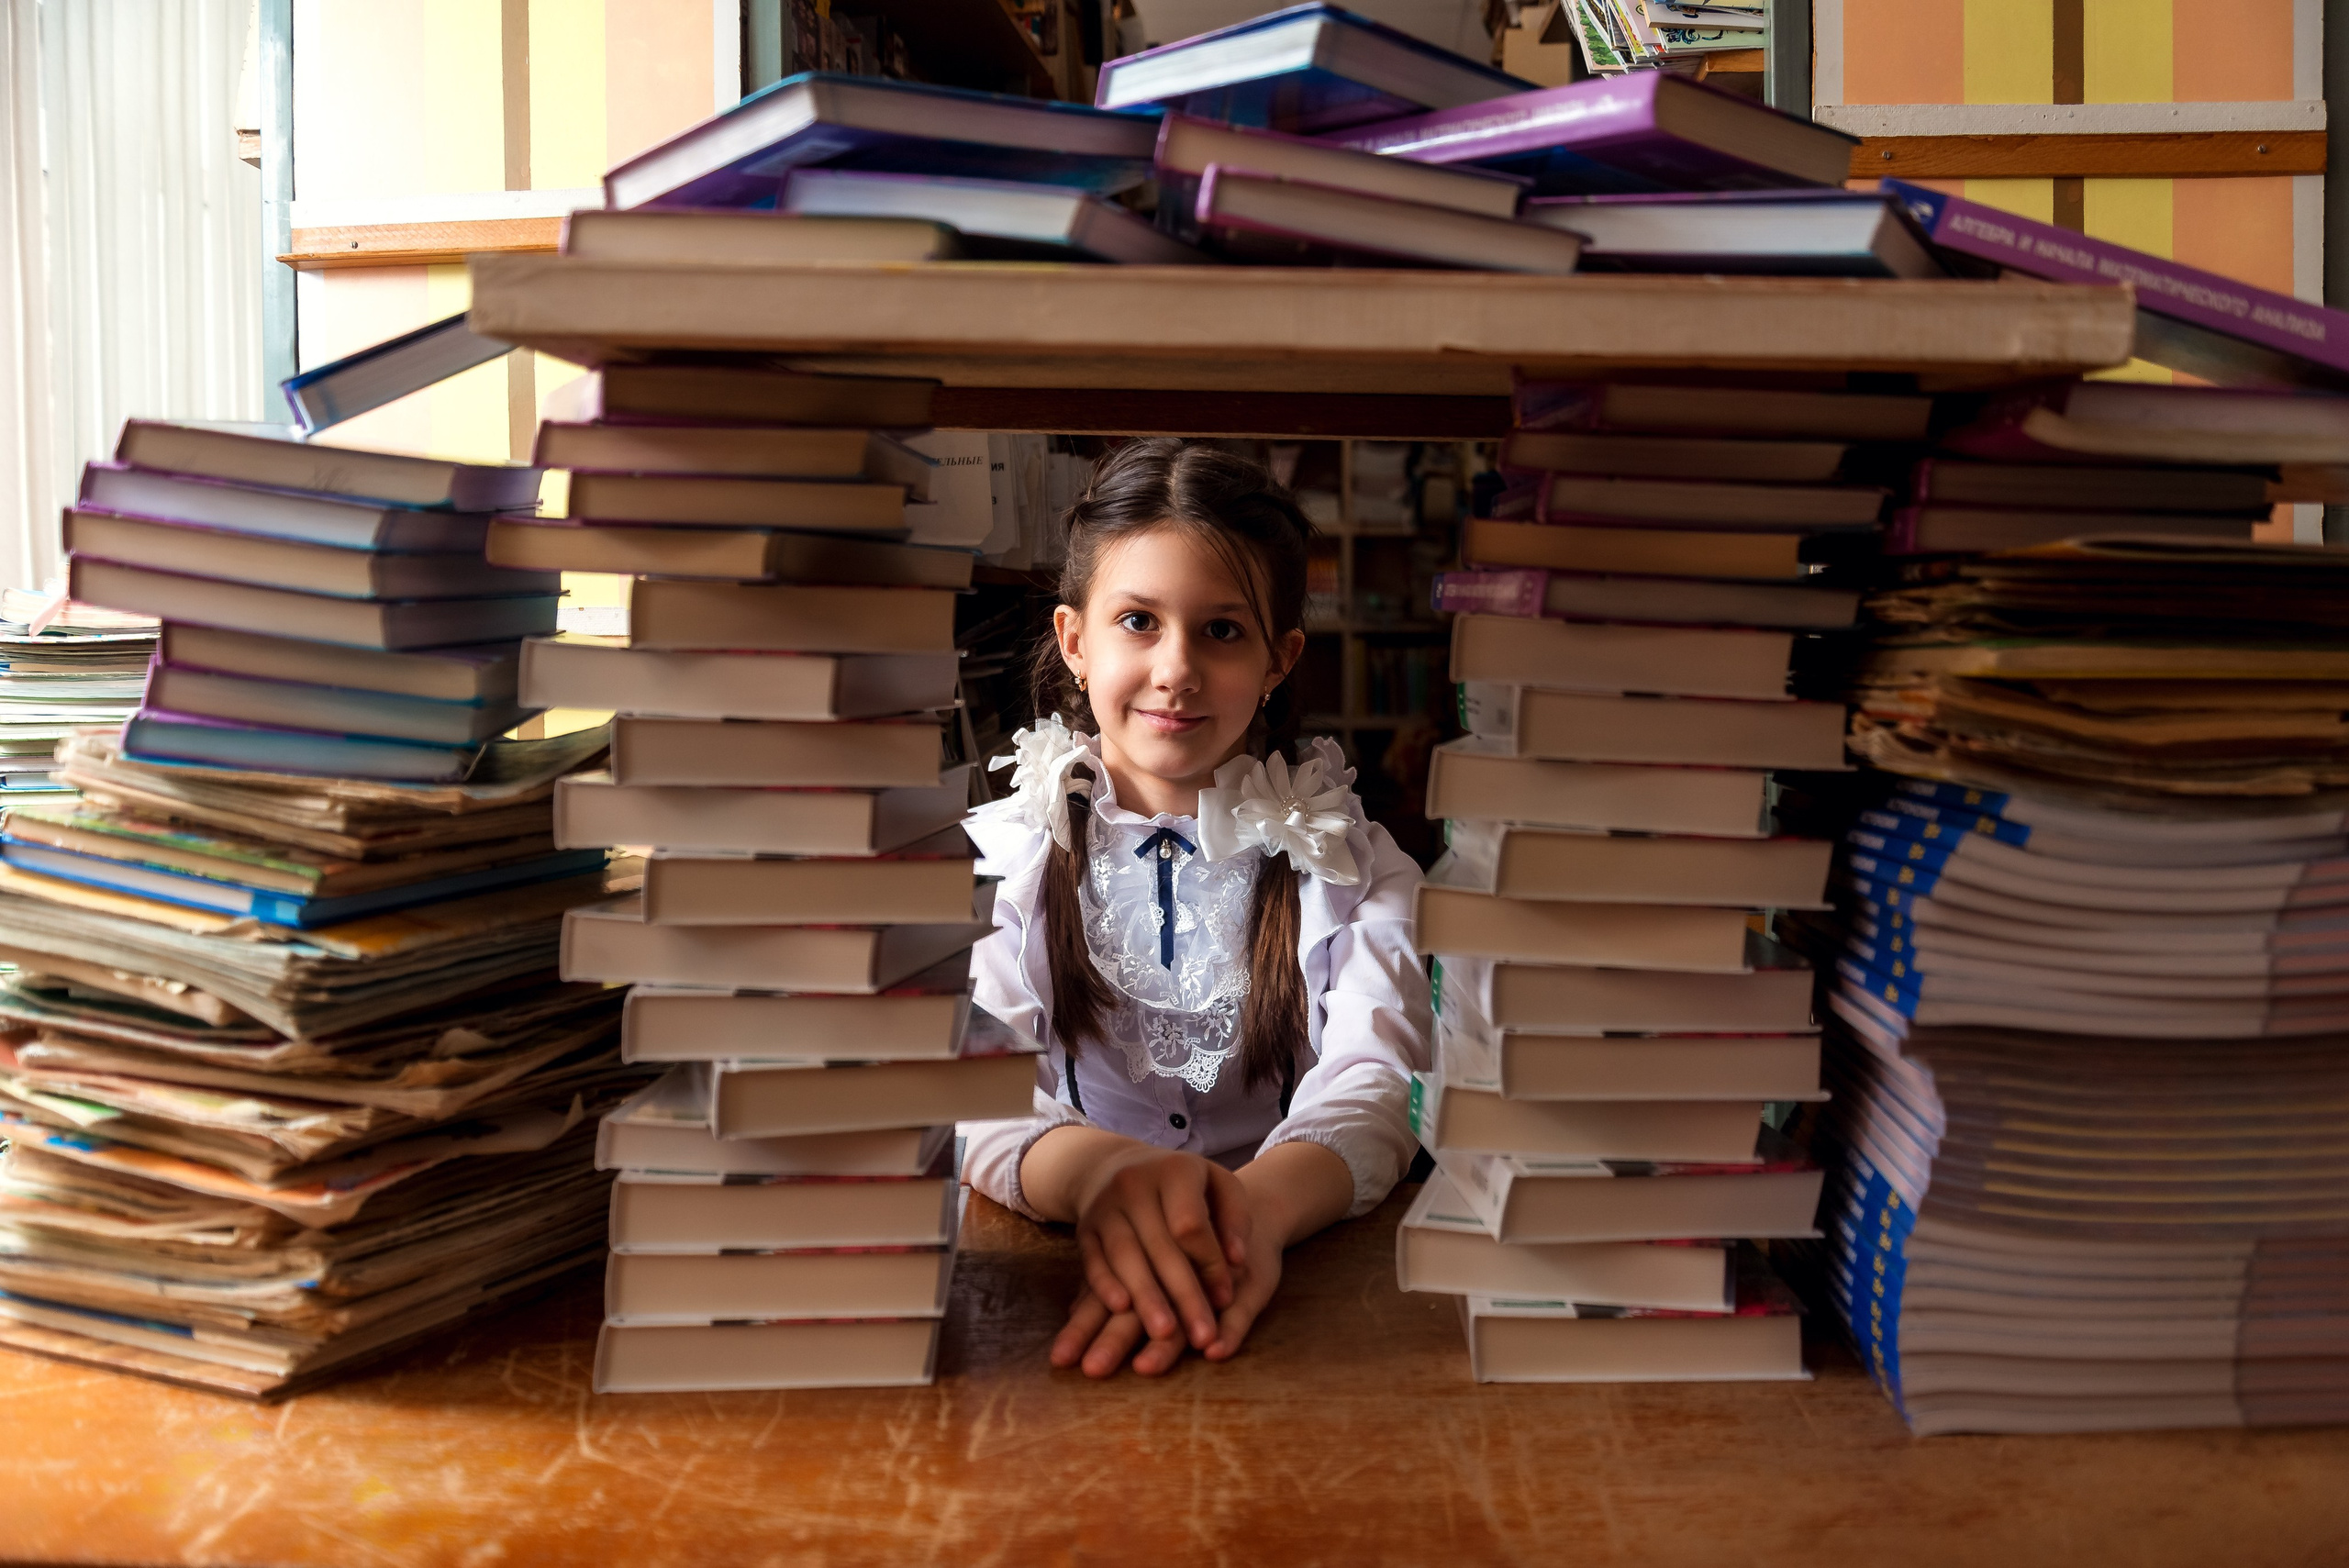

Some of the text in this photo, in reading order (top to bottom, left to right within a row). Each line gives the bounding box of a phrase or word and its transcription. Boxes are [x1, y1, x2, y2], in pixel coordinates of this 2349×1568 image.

[1951, 216, 2015, 246] АЛГЕБРА
[2019, 235, 2033, 250] И
[2035, 240, 2094, 270] НАЧАЛА
[2252, 306, 2325, 340] АНАЛИЗА
